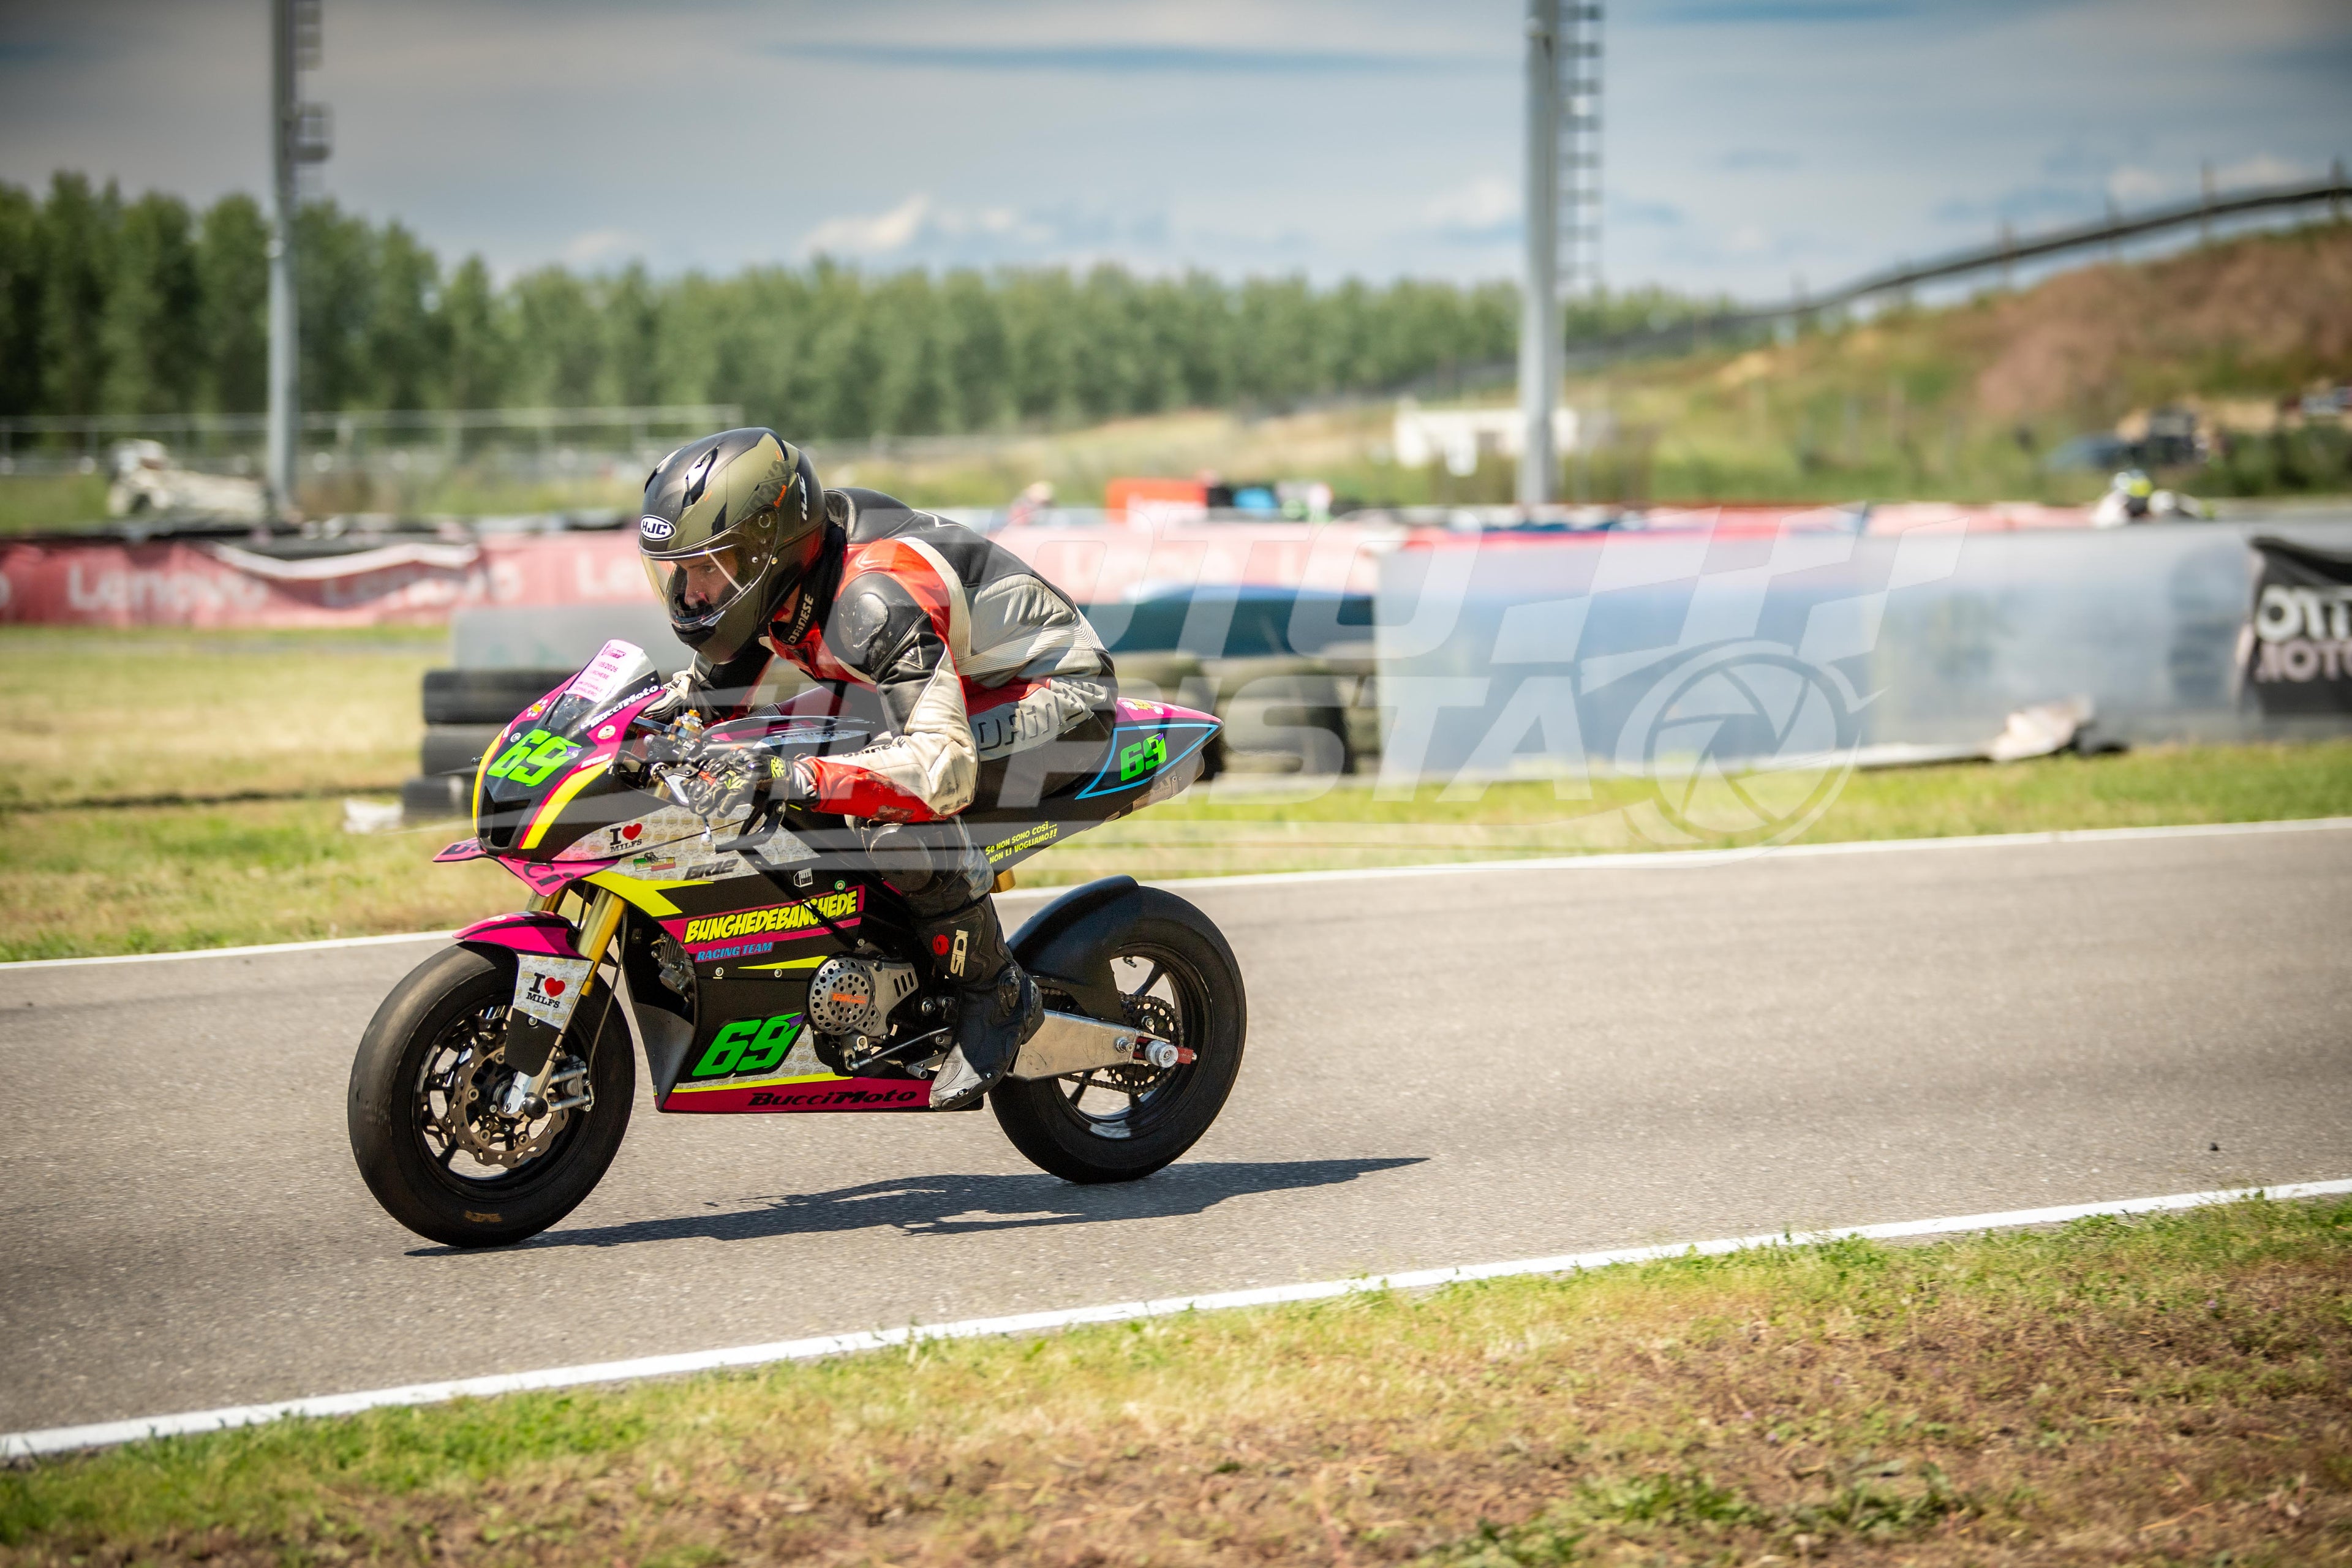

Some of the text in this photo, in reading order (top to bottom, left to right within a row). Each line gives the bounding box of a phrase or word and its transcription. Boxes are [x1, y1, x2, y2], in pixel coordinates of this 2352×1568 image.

[642, 521, 668, 535] HJC
[788, 593, 814, 645] DAINESE
[487, 729, 582, 787] 69
[1120, 733, 1167, 782] 69
[609, 827, 622, 846] I
[609, 839, 643, 853] MILFS
[989, 828, 1058, 864] NON LI VOGLIAMO!!
[996, 838, 1010, 851] NON
[1011, 830, 1030, 844] SONO
[696, 941, 773, 962] RACING TEAM
[529, 972, 546, 994] I
[526, 992, 560, 1009] MILFS
[692, 1012, 802, 1077] 69
[747, 1088, 918, 1107] BucciMoto
